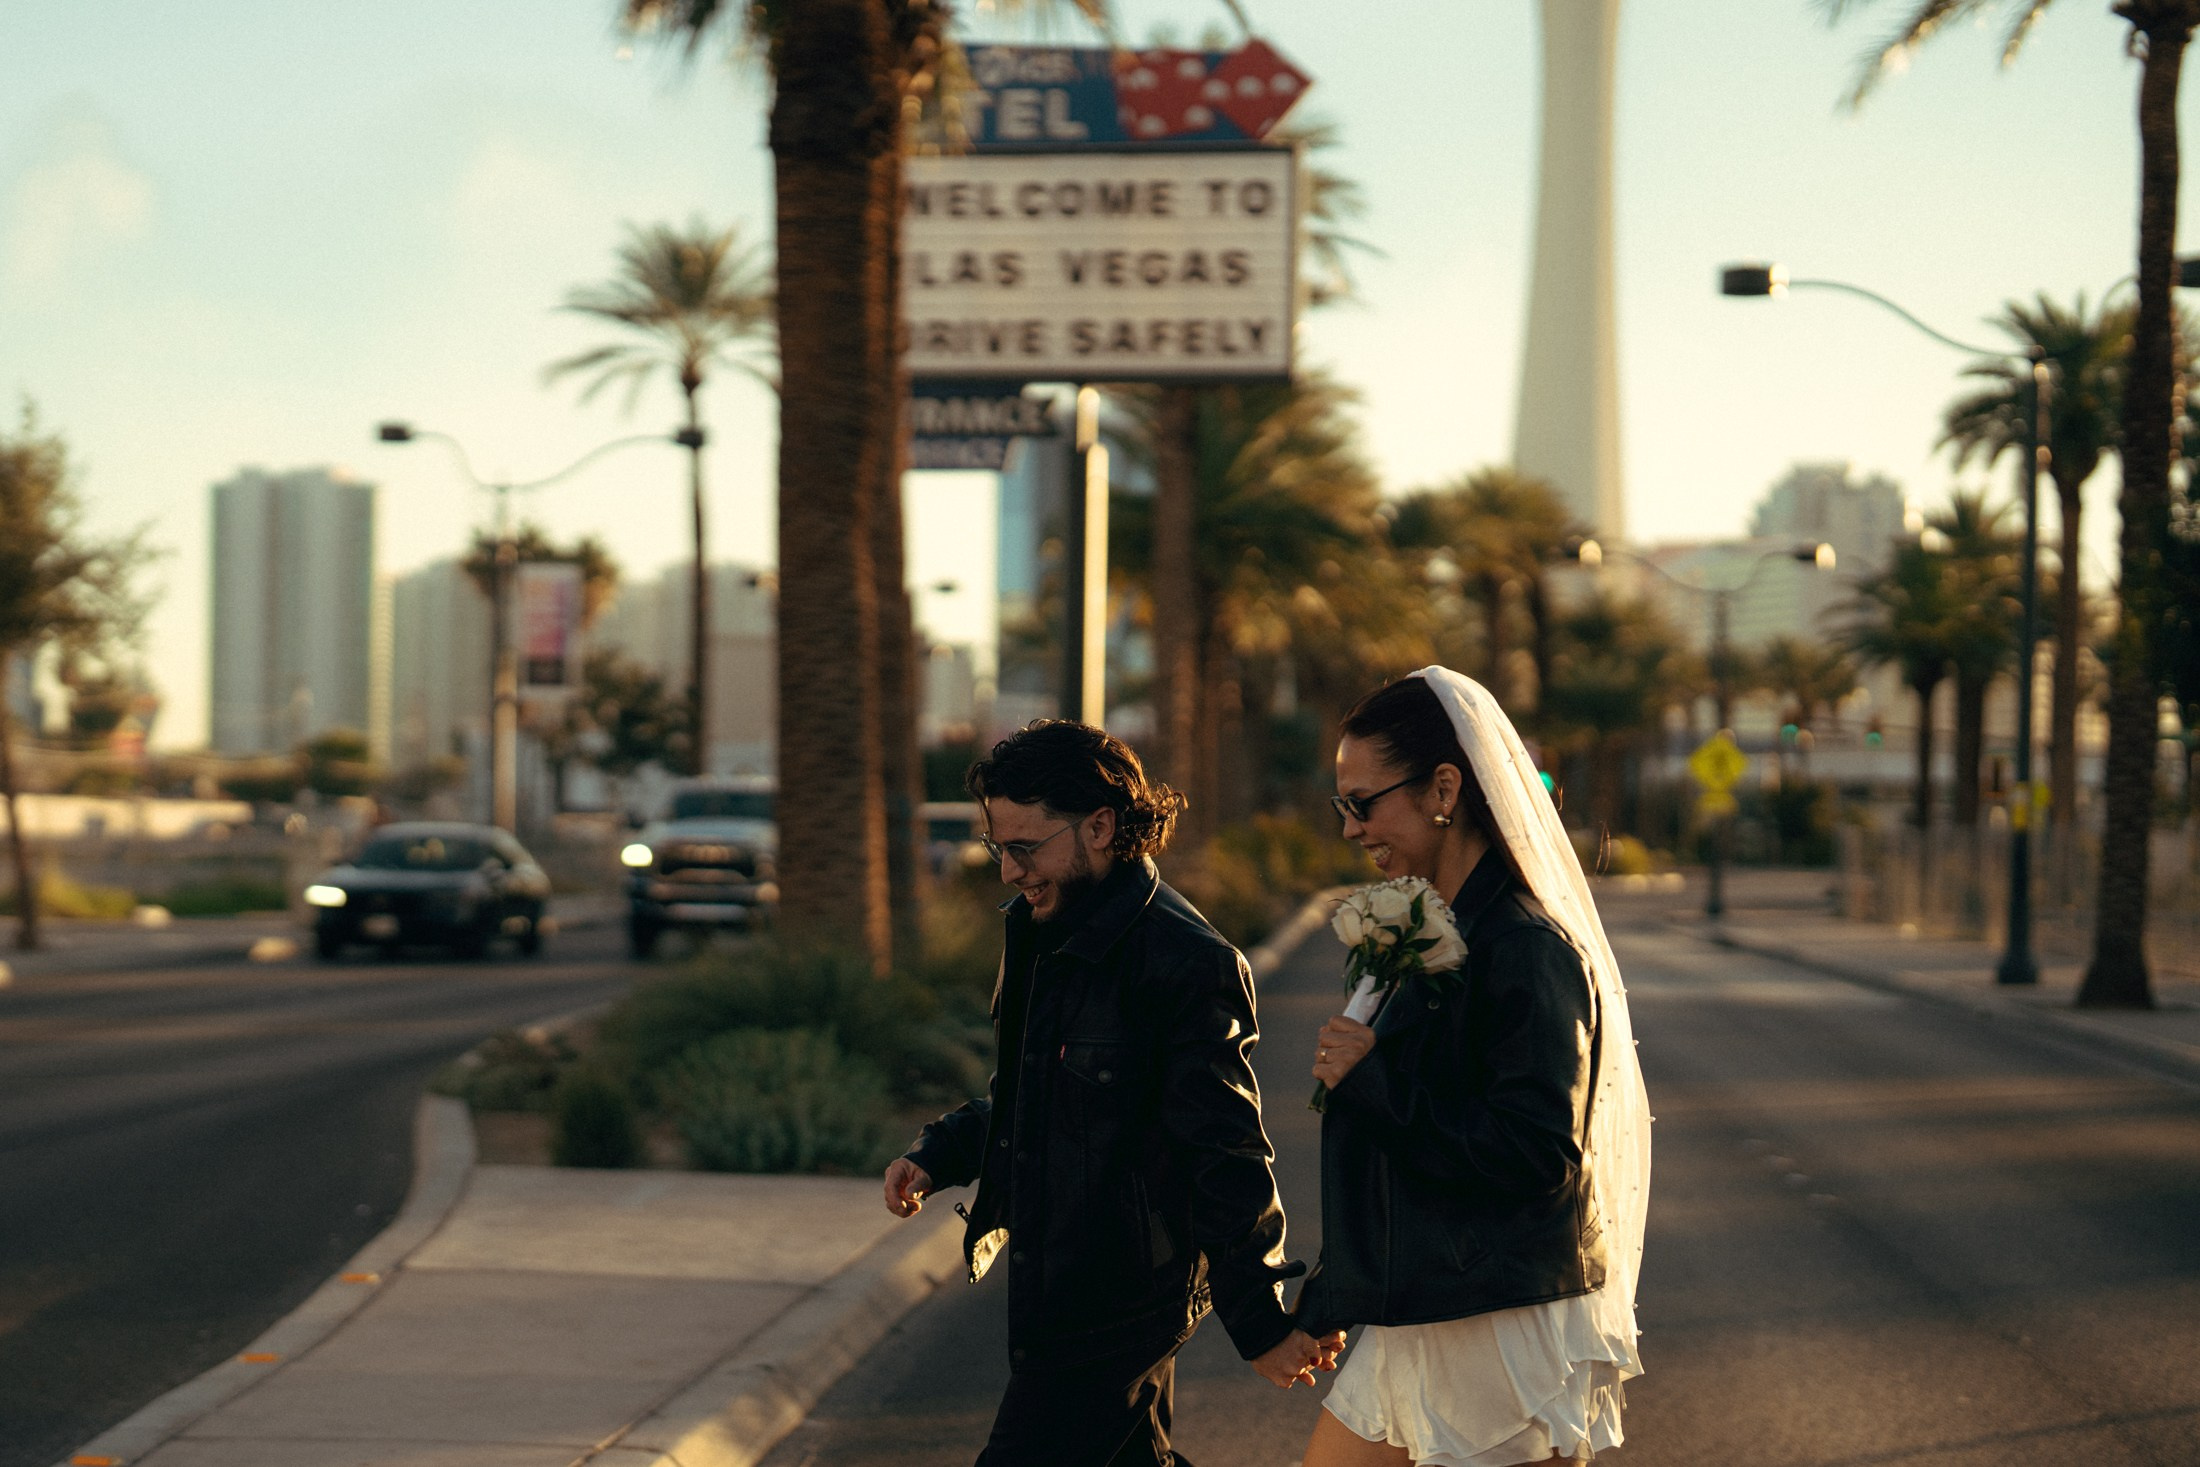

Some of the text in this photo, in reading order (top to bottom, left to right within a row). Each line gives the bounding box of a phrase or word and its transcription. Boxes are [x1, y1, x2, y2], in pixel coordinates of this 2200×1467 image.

[1204, 180, 1274, 218] TO
[916, 250, 1250, 287] LAS VEGAS
[1069, 318, 1271, 355] SAFELY
